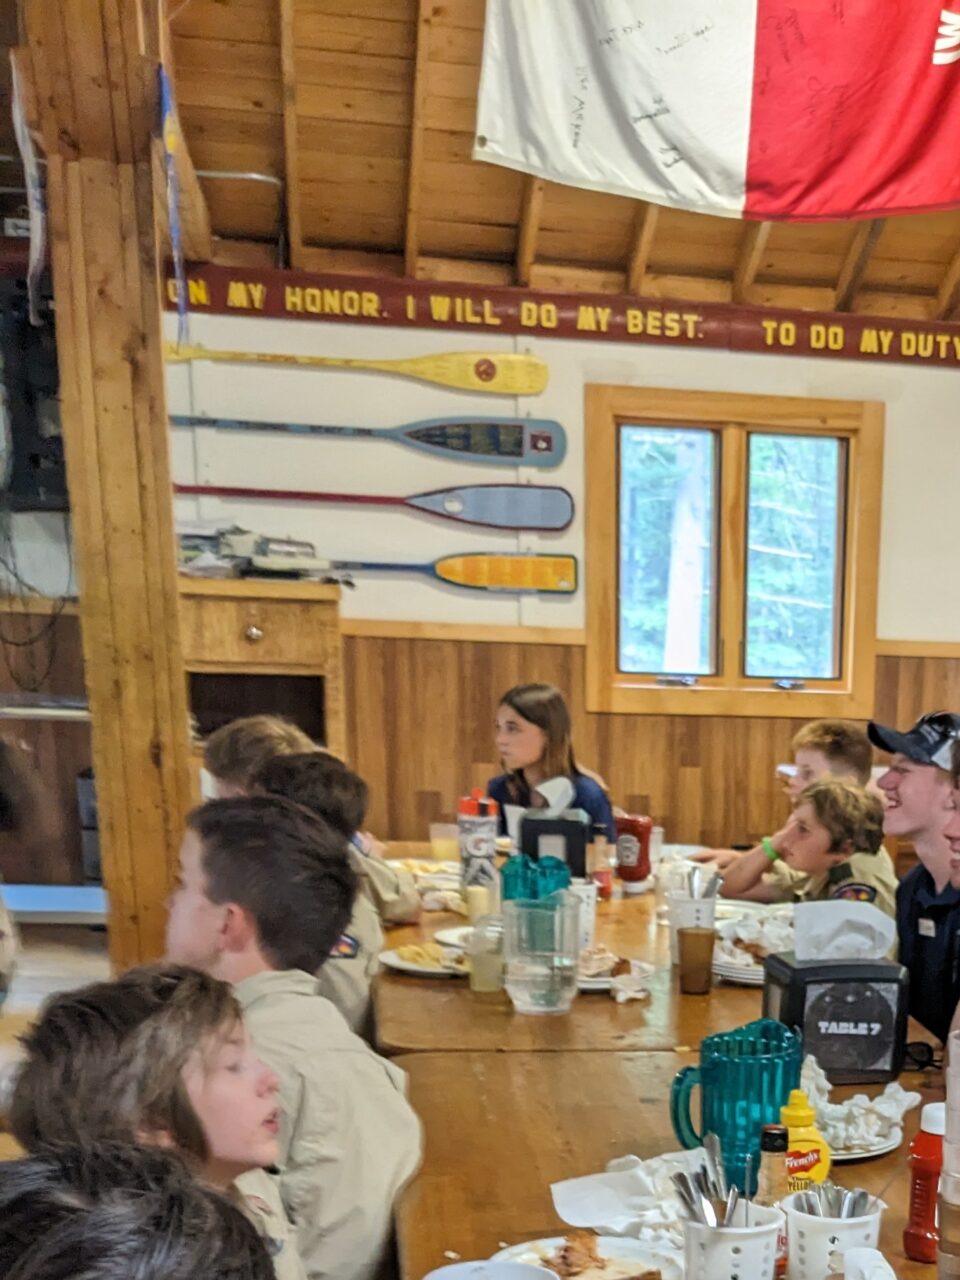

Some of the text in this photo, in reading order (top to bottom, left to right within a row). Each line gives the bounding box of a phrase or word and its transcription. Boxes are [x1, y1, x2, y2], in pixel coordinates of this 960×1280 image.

[227, 281, 266, 310] MY
[406, 294, 416, 320] I
[430, 295, 501, 325] WILL
[520, 301, 559, 328] DO
[575, 304, 612, 332] MY
[761, 320, 796, 346] TO
[810, 324, 845, 350] DO
[860, 328, 895, 354] MY
[818, 1021, 882, 1036] TABLE 7
